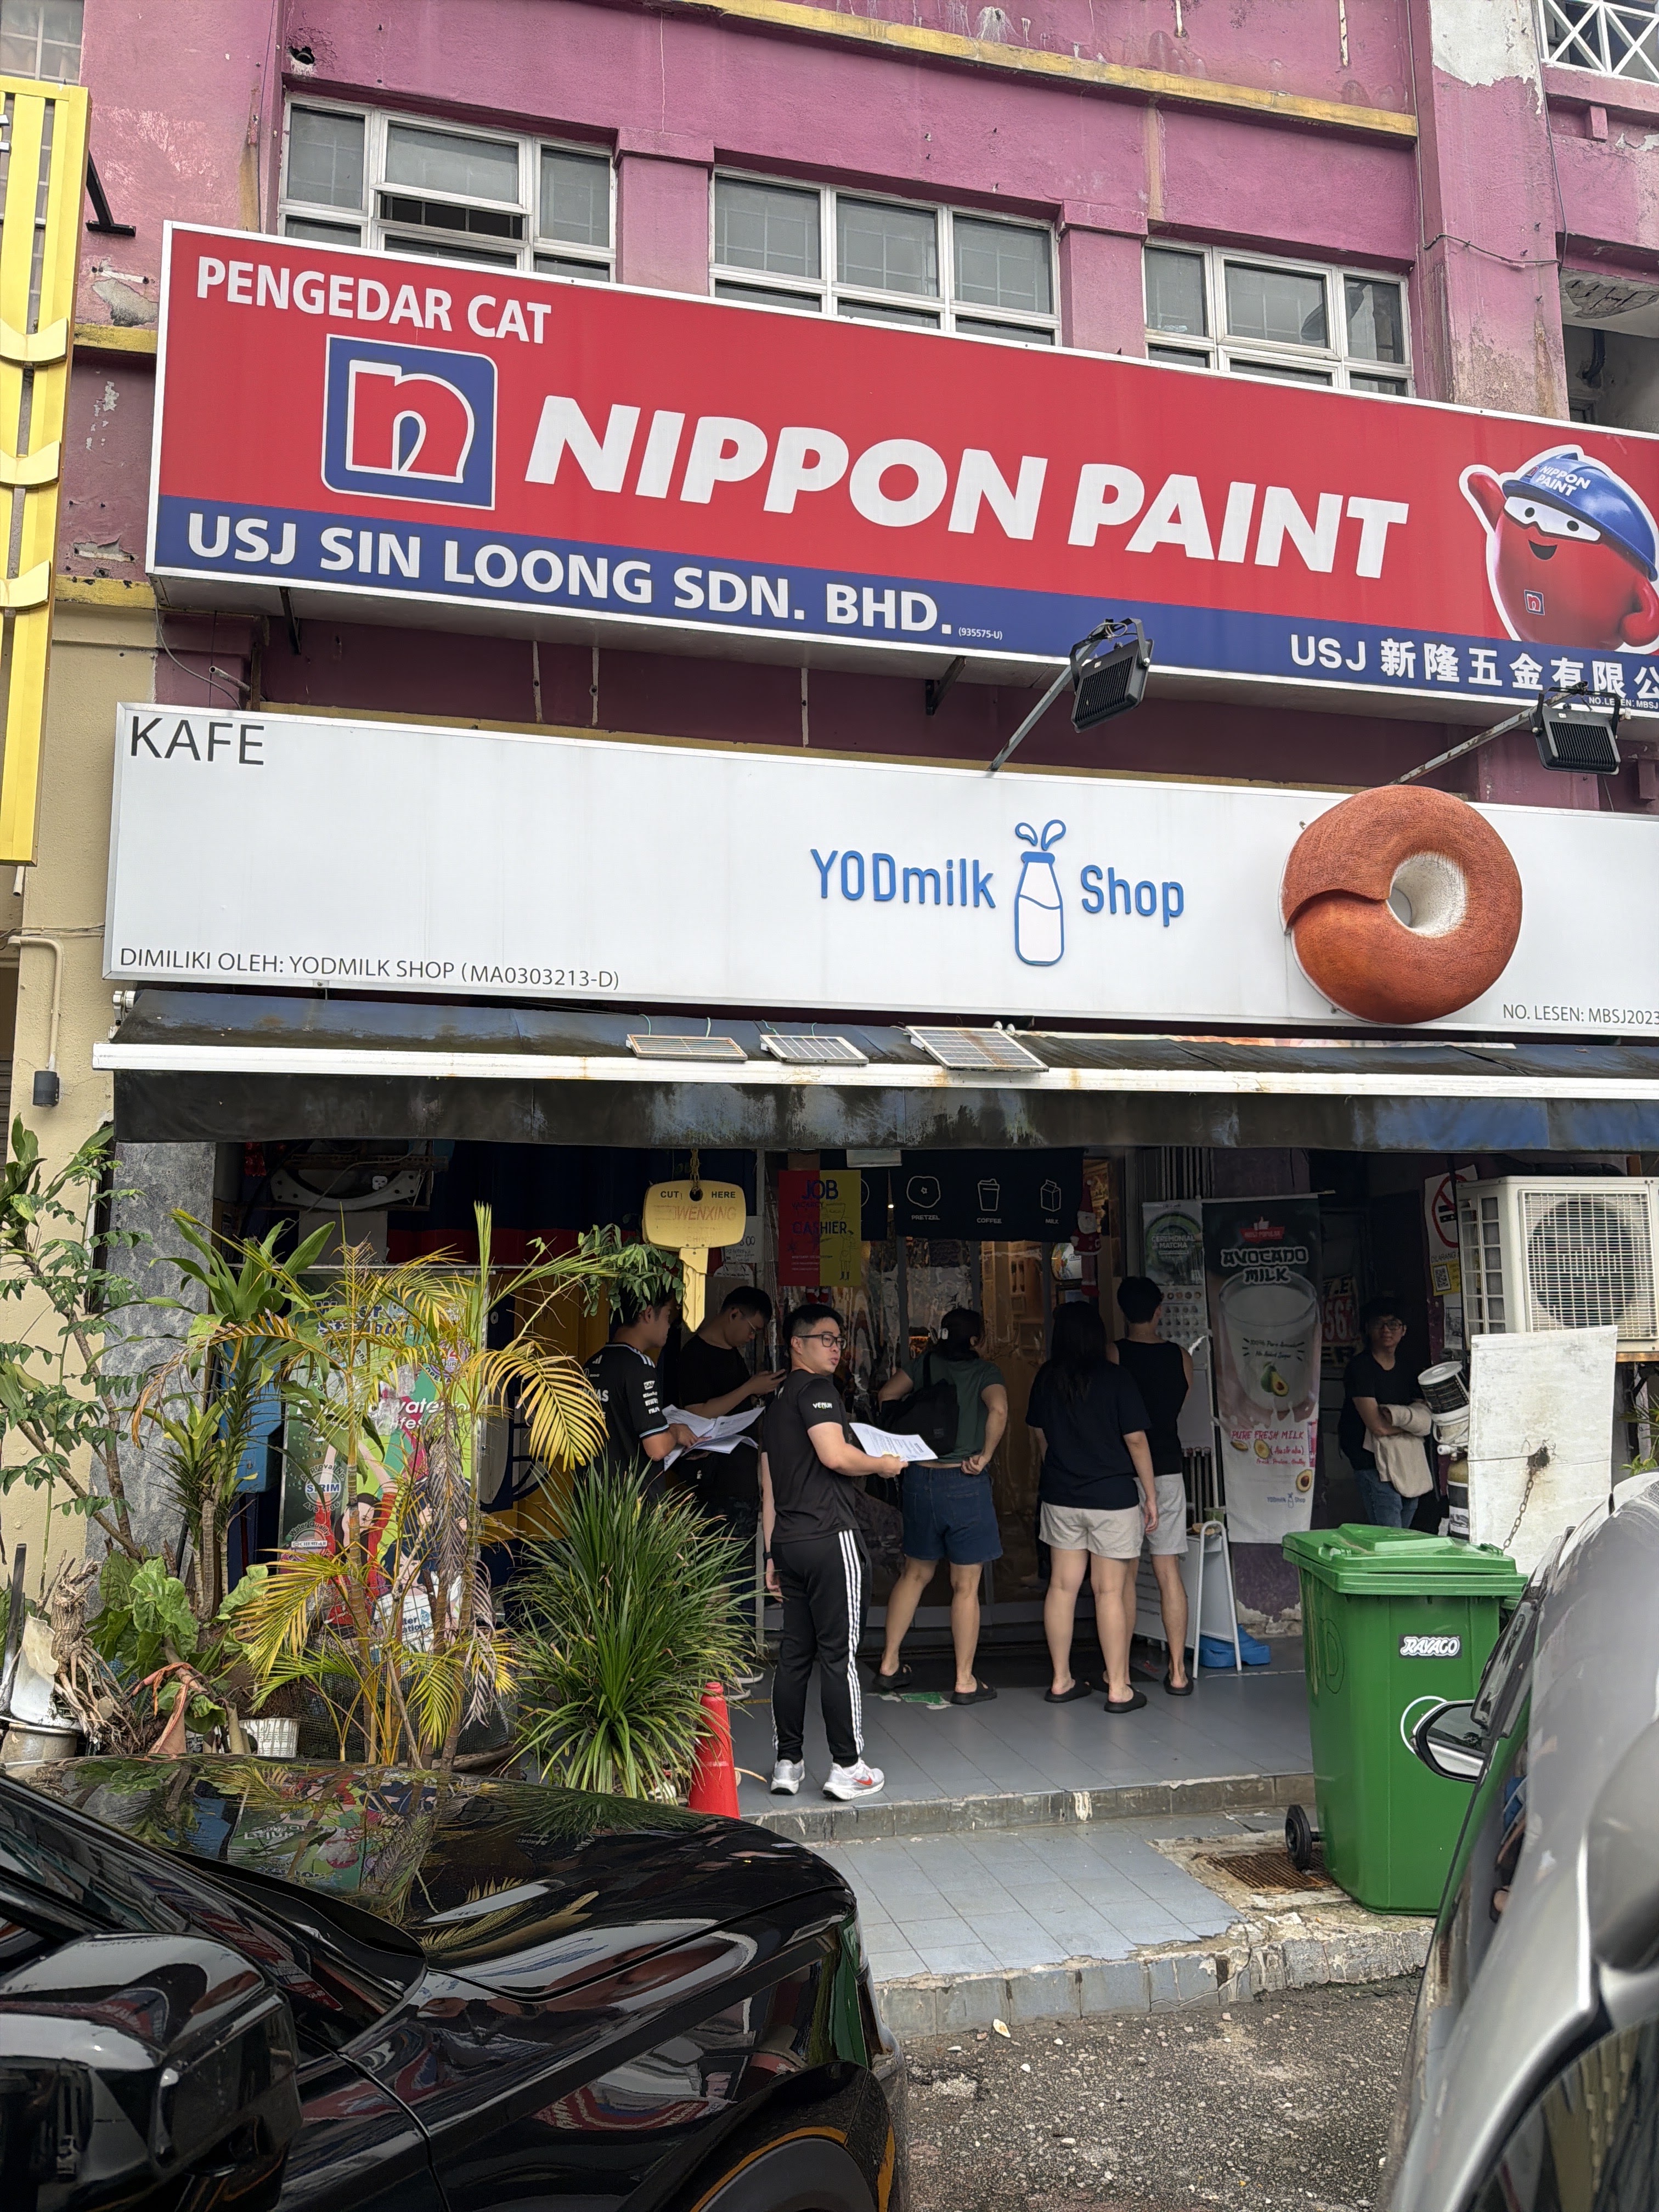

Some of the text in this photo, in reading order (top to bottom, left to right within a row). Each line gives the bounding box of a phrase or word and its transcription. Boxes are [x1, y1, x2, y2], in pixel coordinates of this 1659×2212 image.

[198, 256, 551, 344] PENGEDAR CAT
[525, 395, 1409, 580] NIPPON PAINT
[1536, 474, 1577, 496] PAINT
[1539, 466, 1591, 489] NIPPON
[189, 512, 1003, 640] USJ SIN LOONG SDN. BHD. (935575-U)
[1291, 634, 1366, 671] USJ
[131, 715, 265, 765] KAFE
[811, 849, 1184, 927] YODmilk Shop
[121, 948, 619, 990] DIMILIKI OLEH: YODMILK SHOP (MA0303213-D)
[1503, 1004, 1659, 1025] NO. LESEN: MBSJ2023
[802, 1180, 838, 1200] JOB
[792, 1221, 848, 1234] CASHIER
[1222, 1247, 1308, 1266] AVOCADO
[1244, 1267, 1289, 1283] MILK
[1232, 1430, 1304, 1440] PURE FRESH MILK
[307, 1483, 340, 1492] SRIM
[289, 1521, 330, 1537] Water Quality
